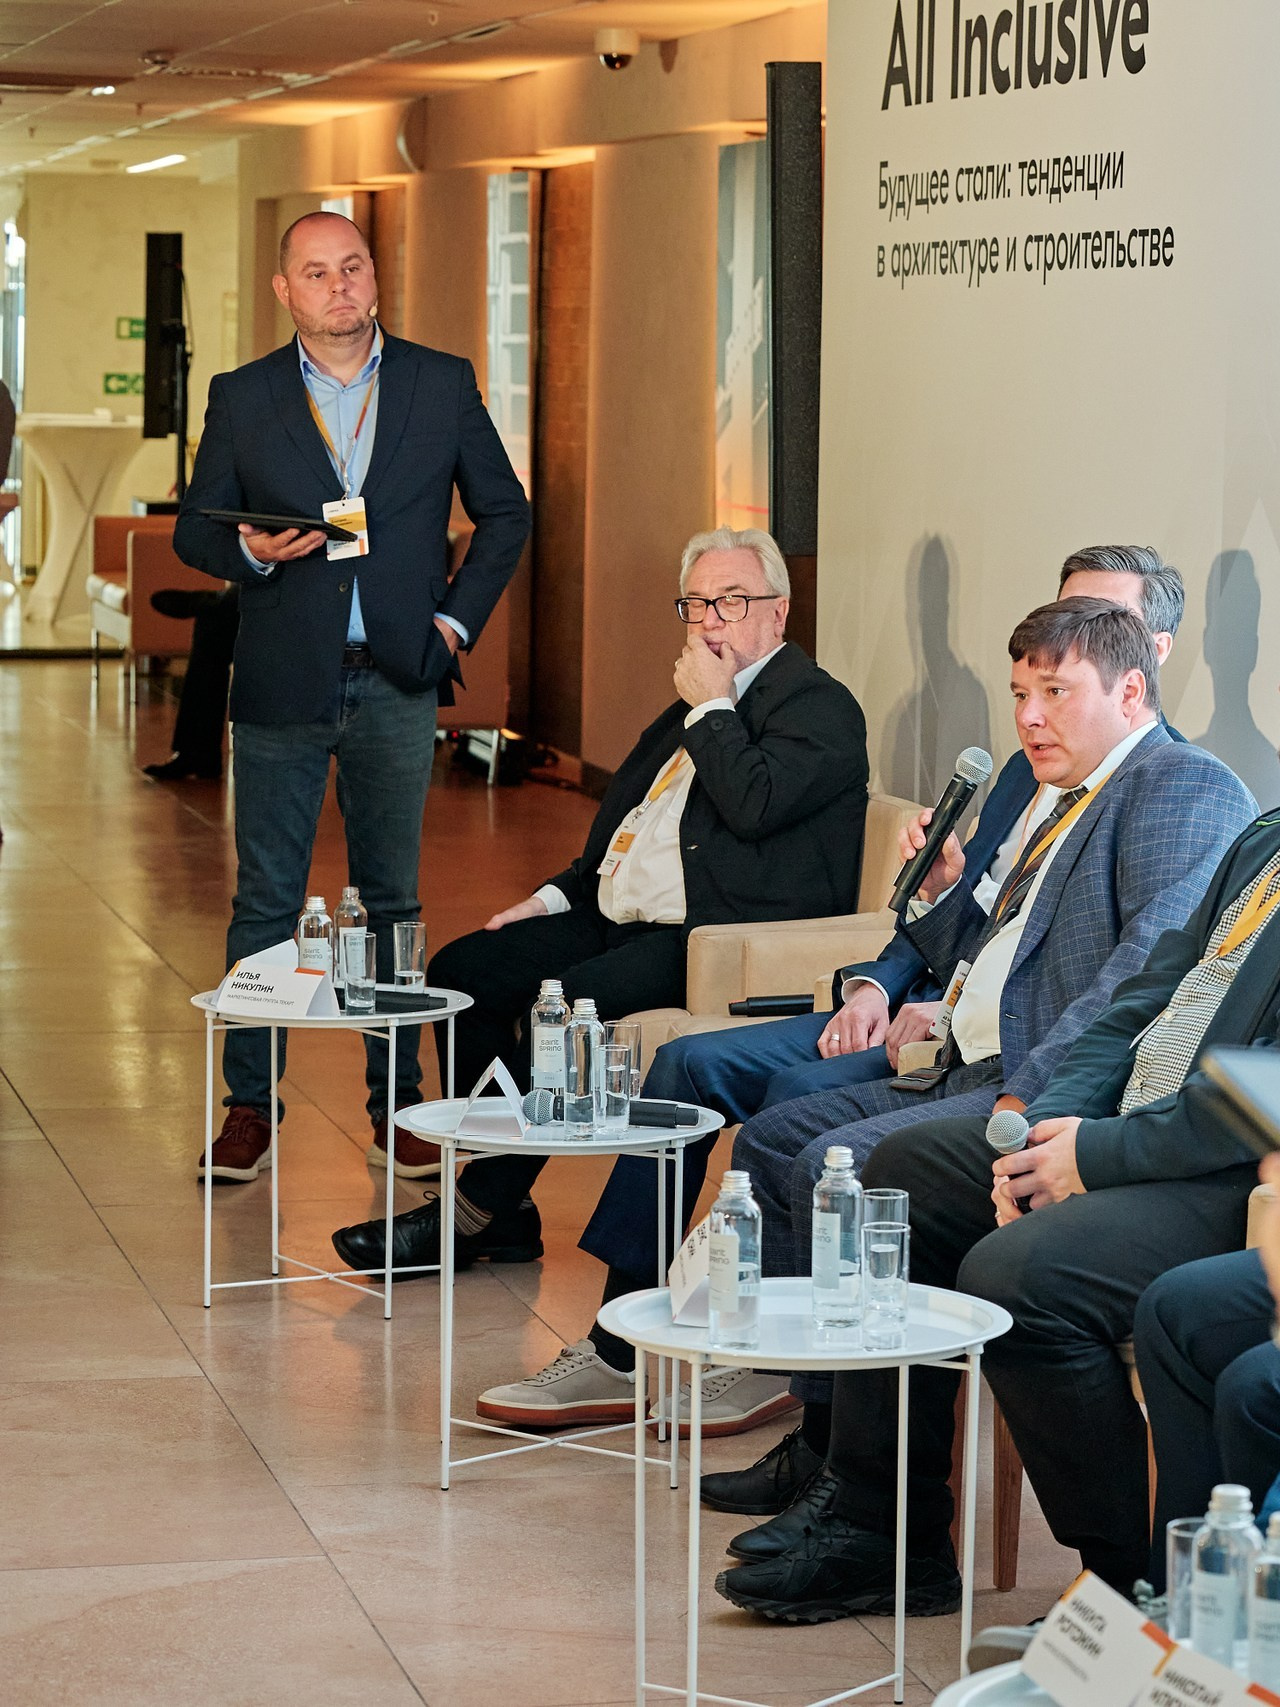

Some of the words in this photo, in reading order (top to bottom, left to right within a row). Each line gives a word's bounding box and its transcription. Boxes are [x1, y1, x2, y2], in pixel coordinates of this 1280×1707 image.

[881, 0, 935, 111] All
[950, 0, 1150, 99] Inclusive
[878, 161, 949, 221] Будущее
[955, 162, 1012, 204] стали:
[1018, 151, 1124, 204] тенденции
[877, 243, 886, 278] в
[891, 233, 999, 290] архитектуре
[1006, 236, 1017, 272] и
[1023, 226, 1175, 285] строительстве
[231, 982, 274, 993] НИКУЛИН
[236, 971, 261, 980] ИЛЬЯ
